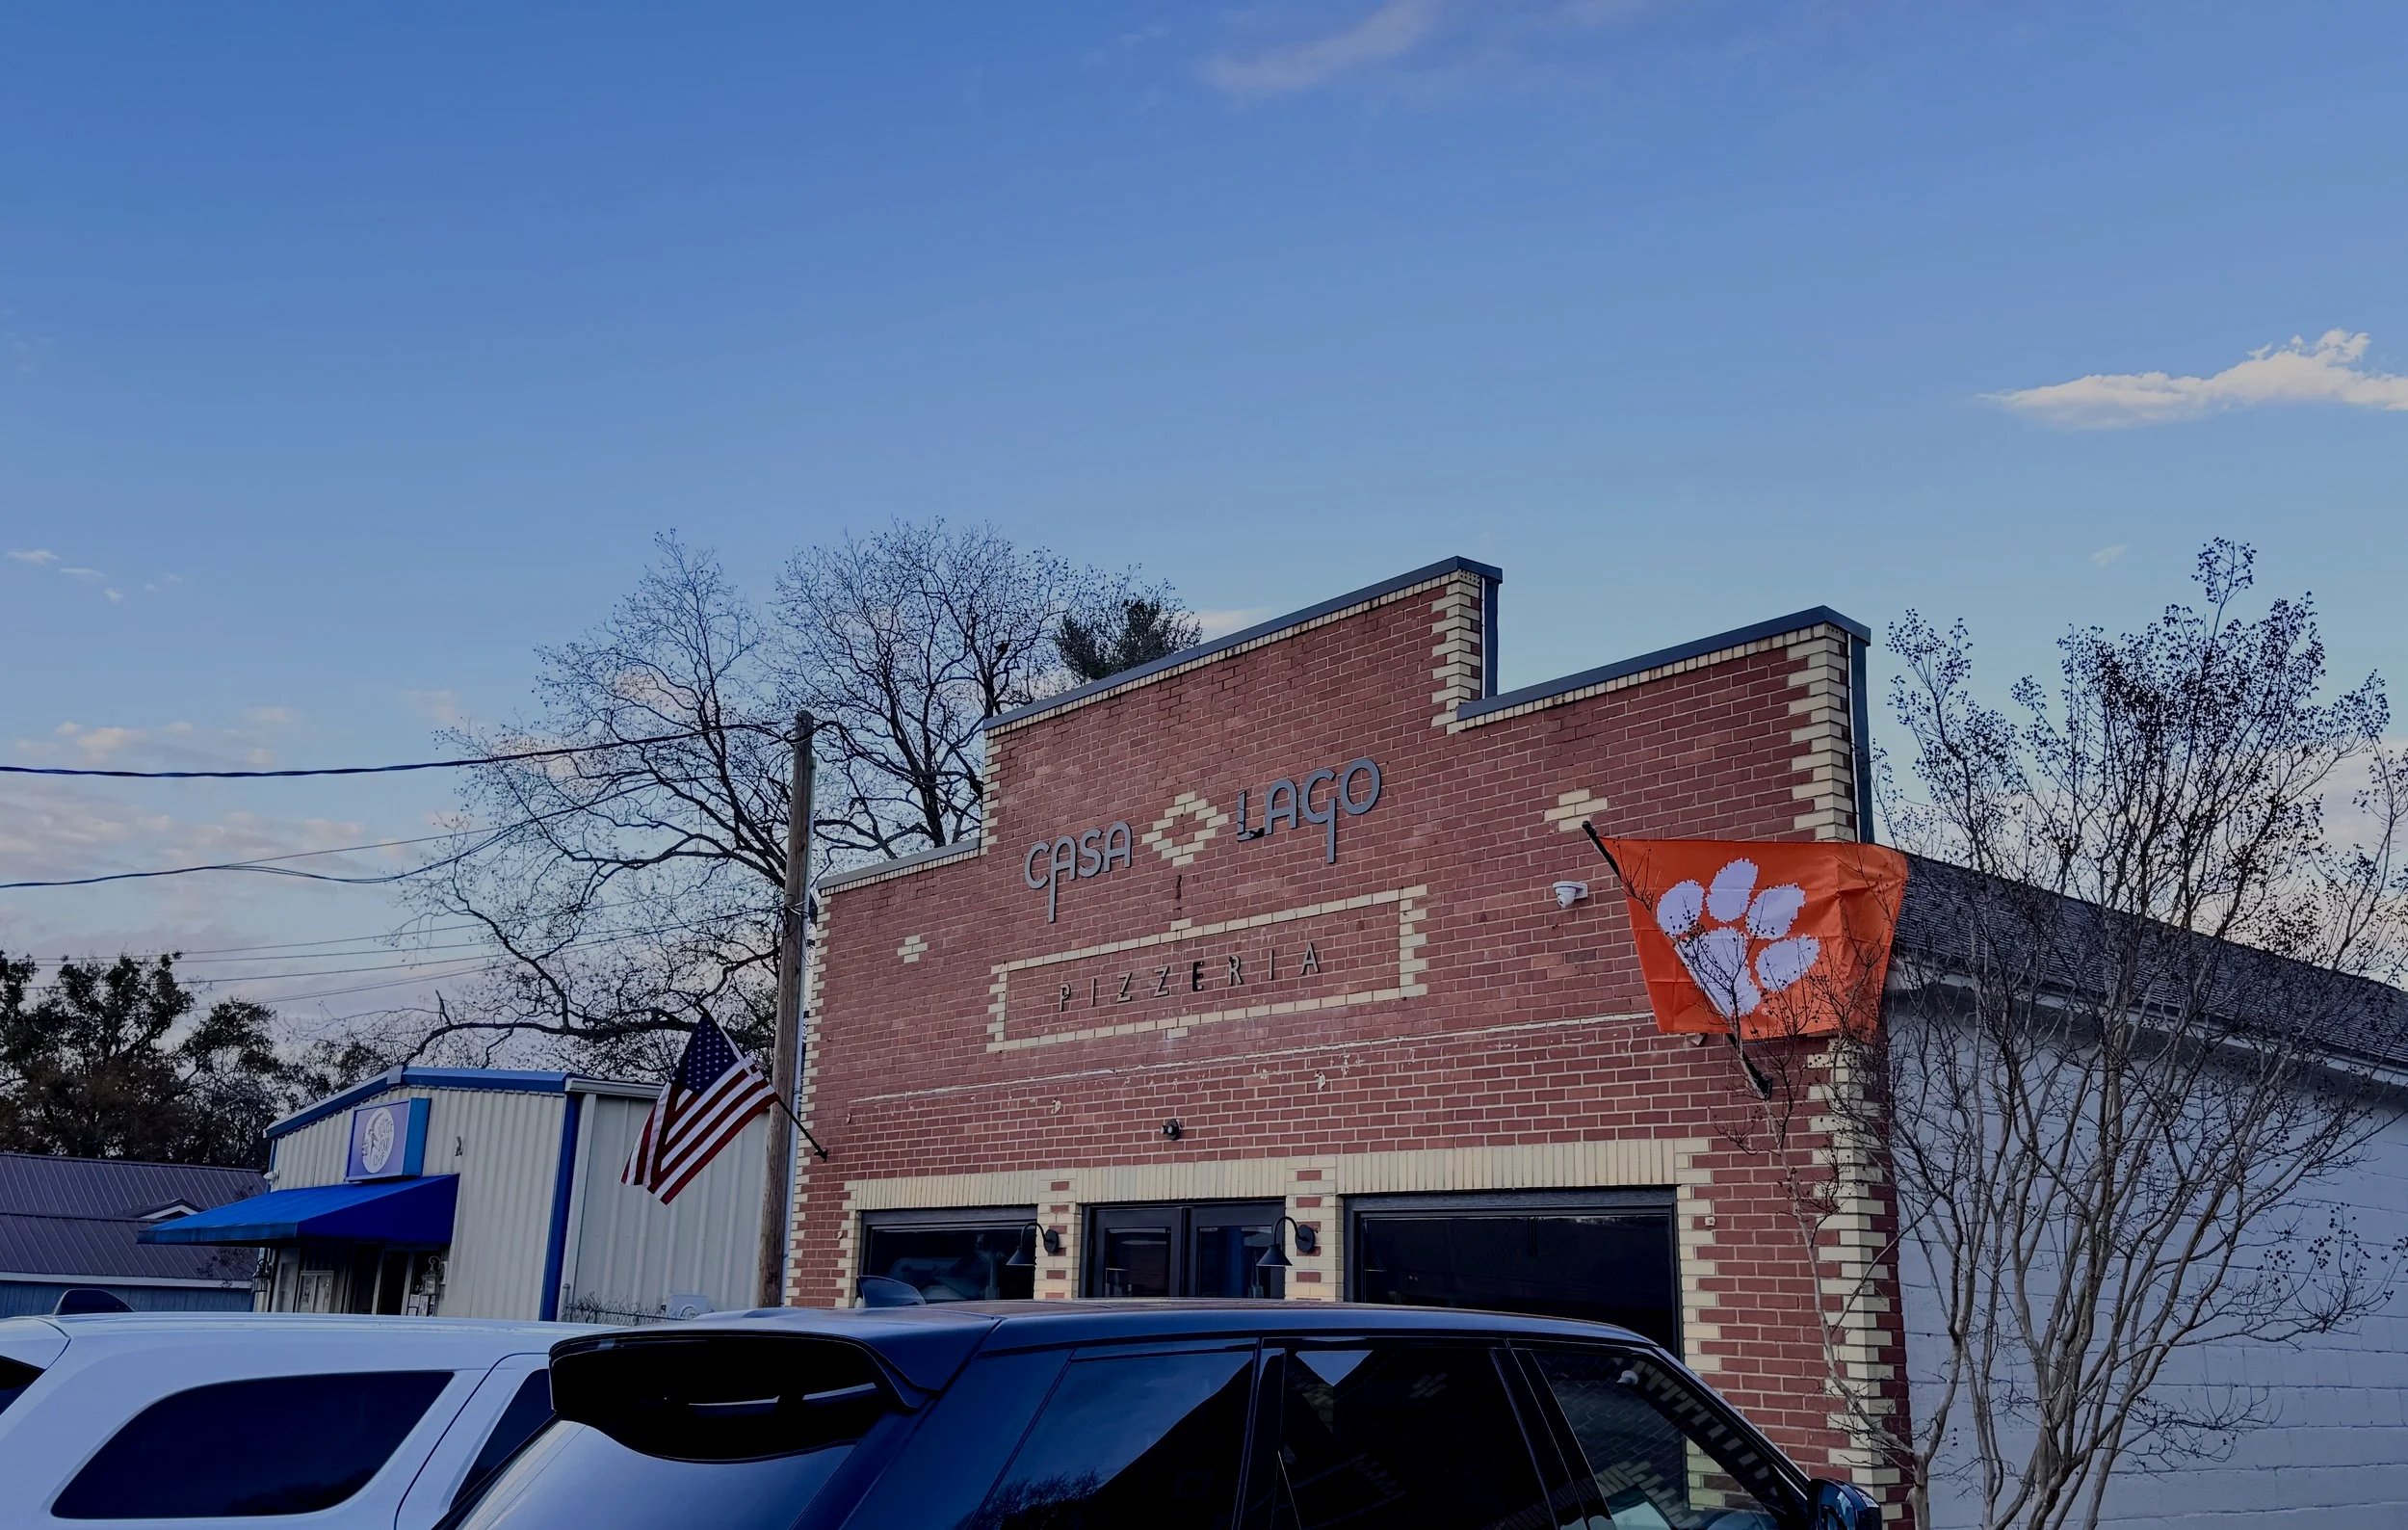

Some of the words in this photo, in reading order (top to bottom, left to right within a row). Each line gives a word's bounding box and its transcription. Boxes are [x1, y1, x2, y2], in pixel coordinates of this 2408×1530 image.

[1024, 821, 1133, 923] CASA
[1237, 757, 1382, 864] LAGO
[1060, 941, 1321, 1012] PIZZERIA
